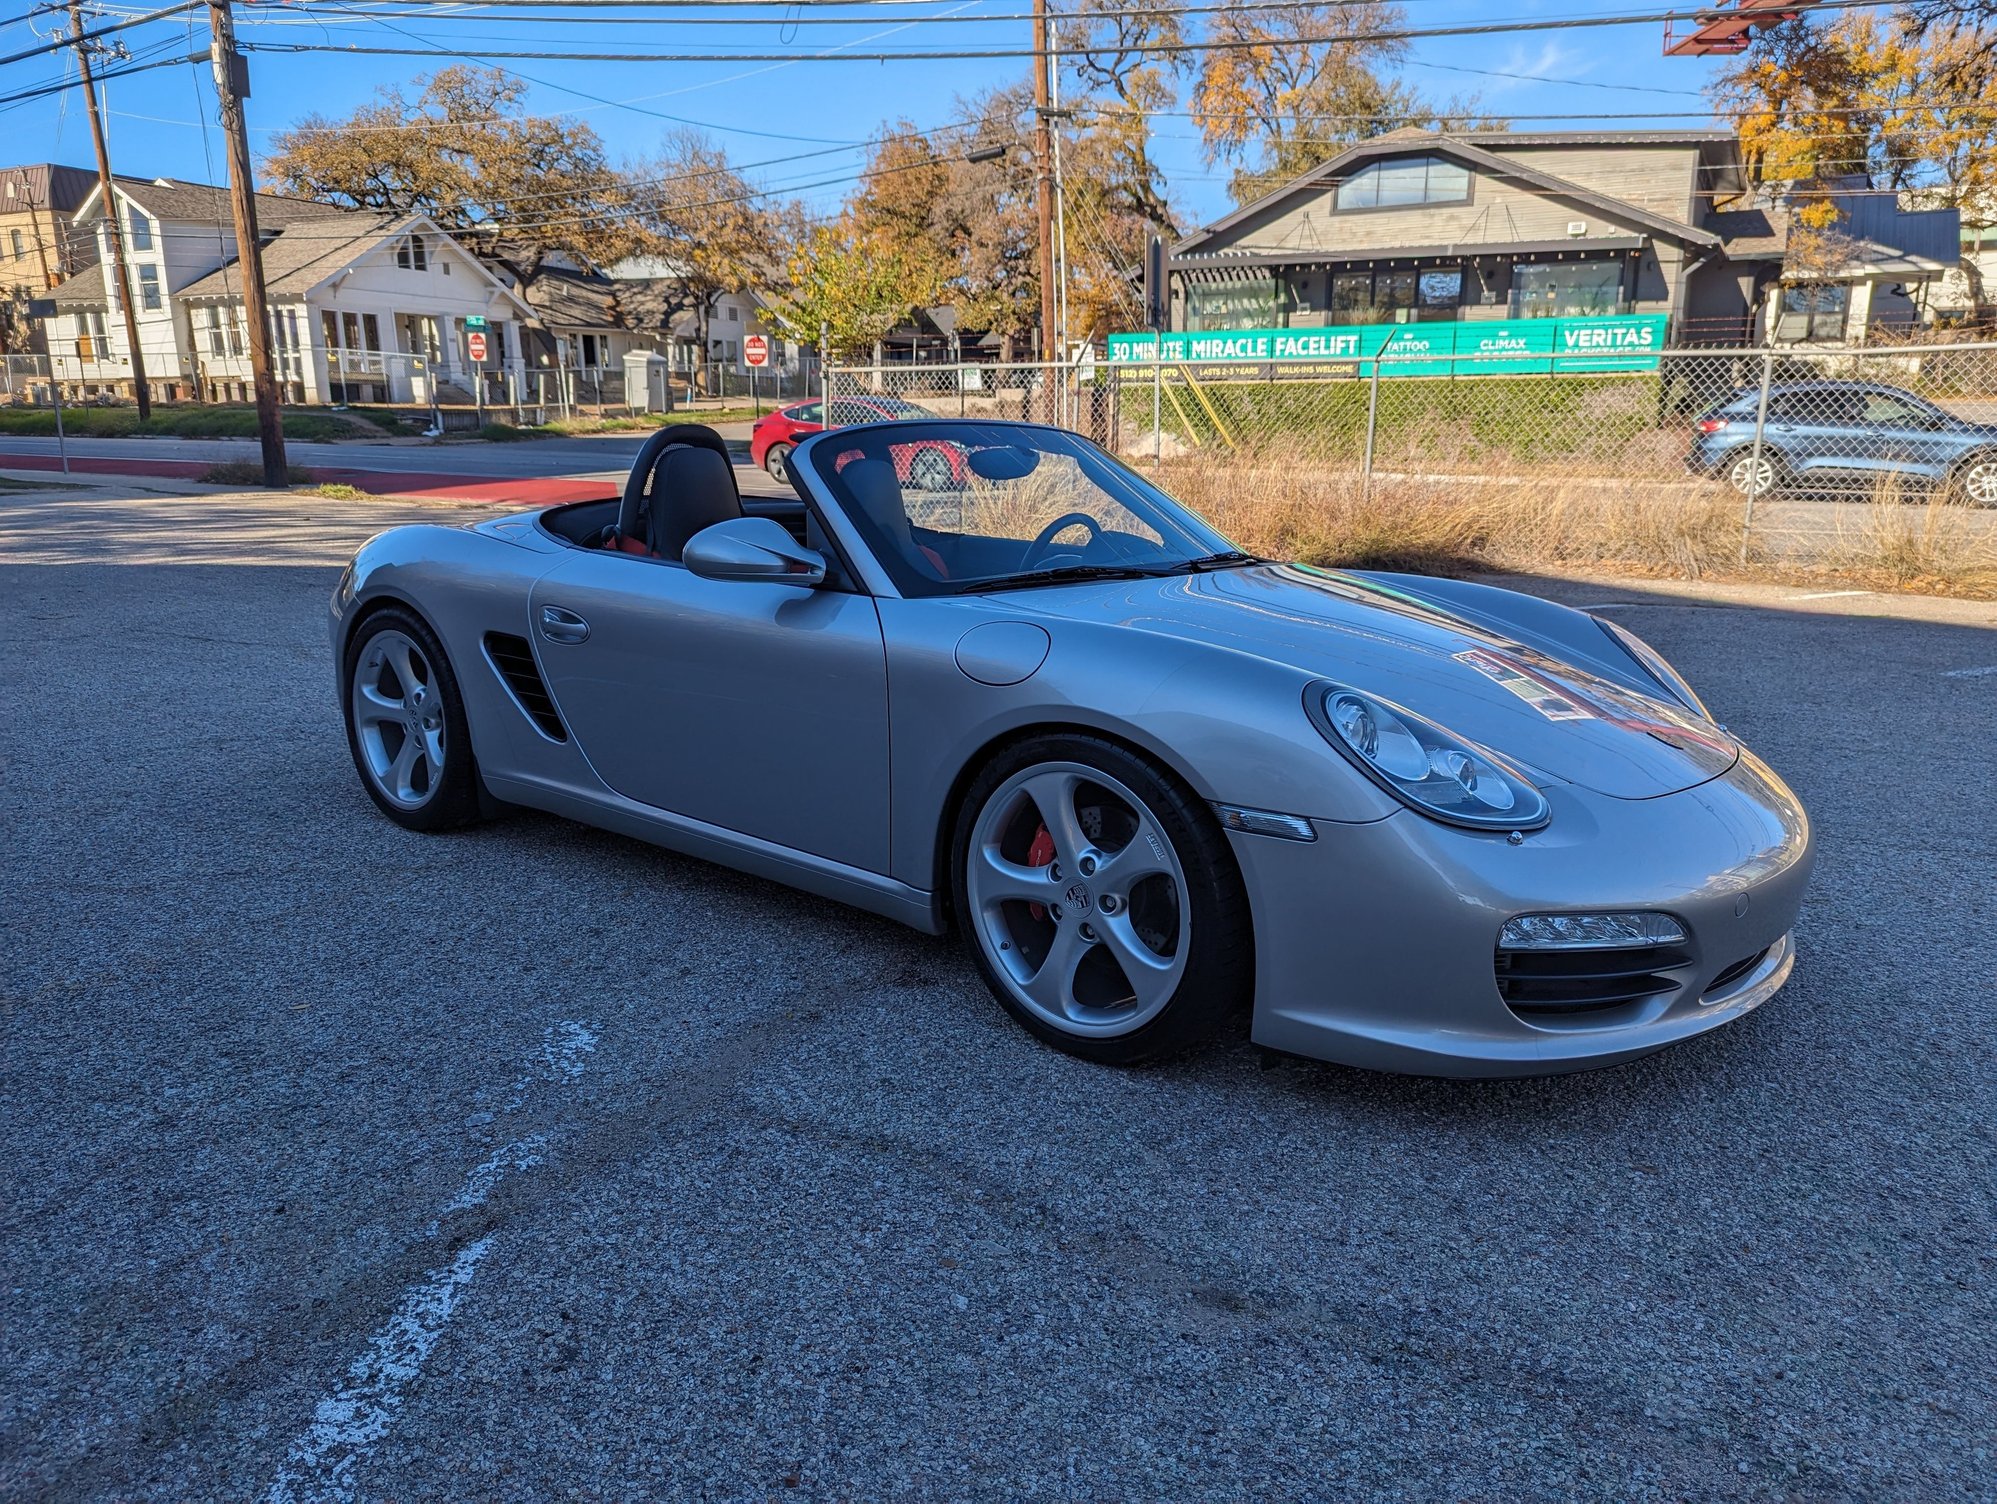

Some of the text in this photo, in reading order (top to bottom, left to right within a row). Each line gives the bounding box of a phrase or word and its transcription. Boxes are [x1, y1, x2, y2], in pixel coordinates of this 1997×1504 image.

[1564, 327, 1653, 347] VERITAS
[1112, 343, 1130, 361] 30
[1192, 338, 1268, 359] MIRACLE
[1276, 335, 1358, 356] FACELIFT
[1387, 340, 1430, 352] TATTOO
[1480, 338, 1526, 350] CLIMAX
[1139, 368, 1178, 378] 910-070
[1200, 368, 1221, 376] LASTS
[1236, 366, 1259, 375] YEARS
[1277, 365, 1354, 374] WALK-INS WELCOME
